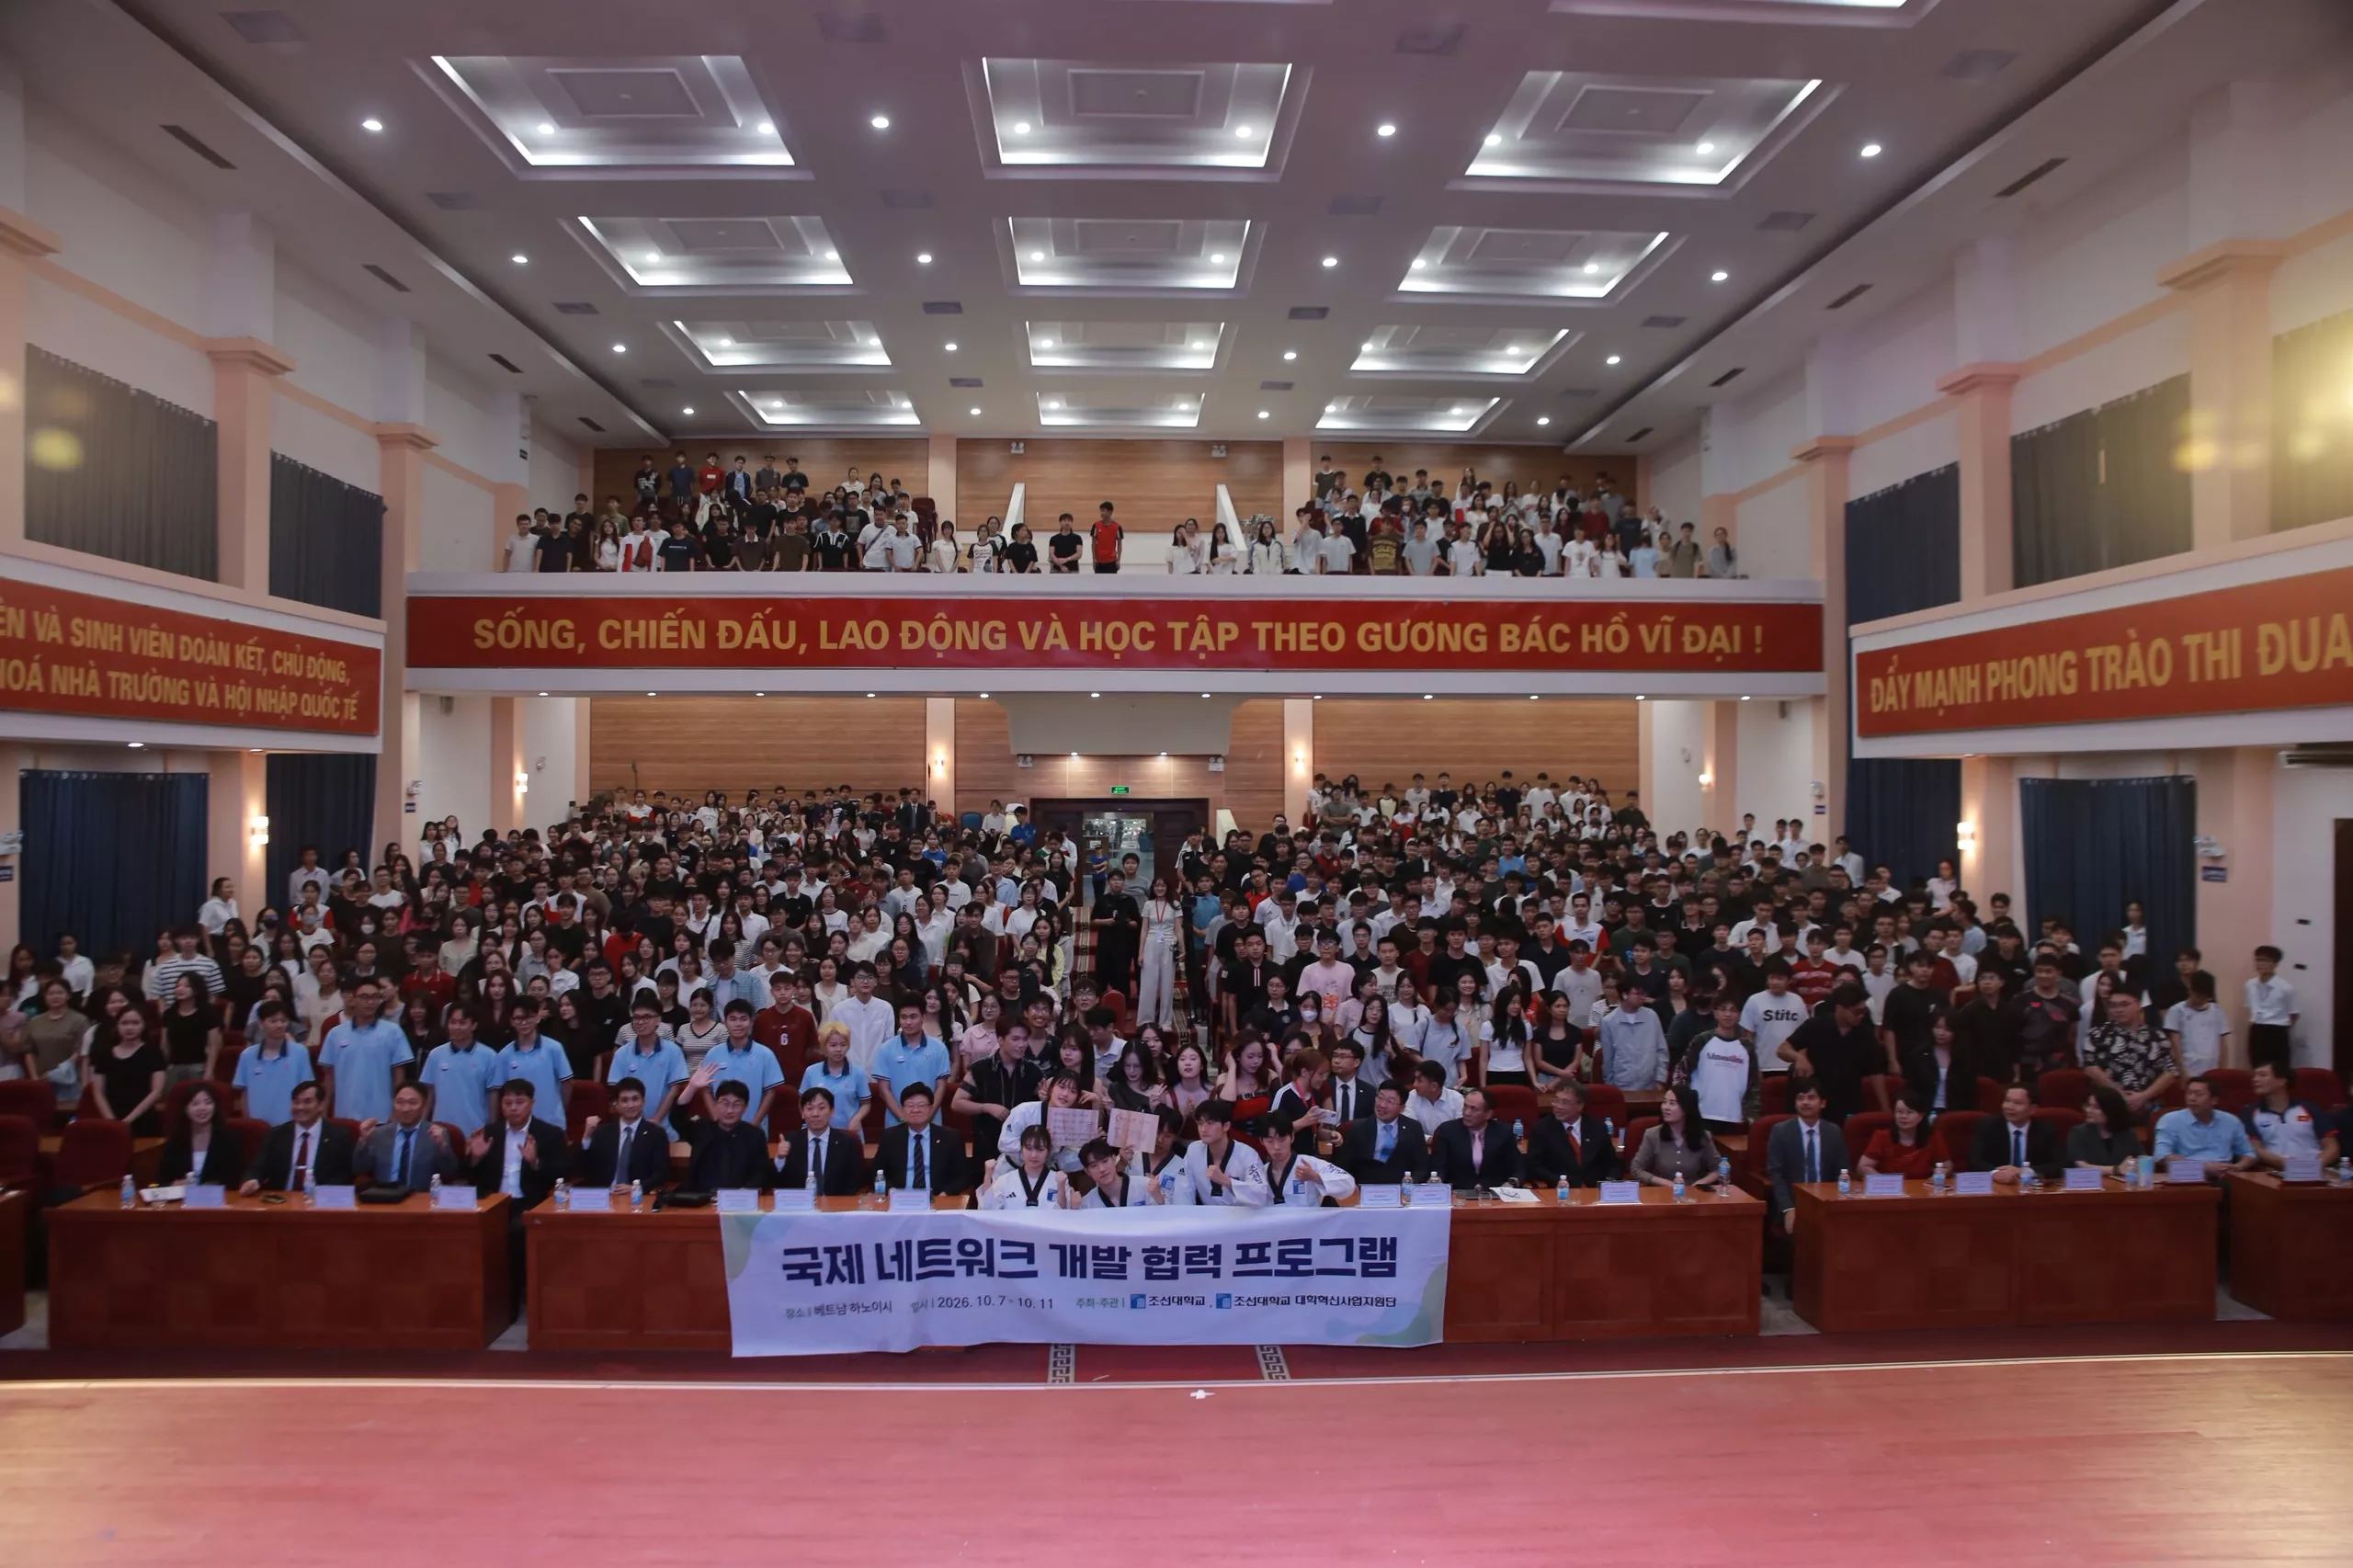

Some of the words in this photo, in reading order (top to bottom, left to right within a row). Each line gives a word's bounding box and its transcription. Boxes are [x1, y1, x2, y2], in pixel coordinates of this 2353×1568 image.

[33, 605, 63, 644] VÀ
[70, 617, 123, 652] SINH
[129, 623, 175, 660] VIÊN
[178, 631, 230, 666] ĐOÀN
[234, 636, 267, 676] KẾT,
[272, 644, 303, 677] CHỦ
[306, 652, 351, 687] ĐỘNG,
[473, 607, 585, 653] SỐNG,
[598, 608, 706, 650] CHIẾN
[717, 608, 807, 654] ĐẤU,
[819, 620, 890, 650] LAO
[899, 613, 1007, 658] ĐỘNG
[1017, 613, 1070, 651] VÀ
[1080, 620, 1155, 659] HỌC
[1167, 614, 1239, 659] TẬP
[1252, 621, 1346, 652] THEO
[1356, 619, 1487, 653] GƯƠNG
[1500, 614, 1571, 653] BÁC
[1582, 611, 1630, 653] HỒ
[1638, 615, 1675, 653] VĨ
[1681, 624, 1742, 662] ĐẠI
[1755, 625, 1764, 653] !
[1870, 653, 1912, 713] ĐẨY
[1915, 664, 1981, 717] MẠNH
[1985, 650, 2078, 702] PHONG
[2084, 628, 2173, 692] TRÀO
[2181, 628, 2242, 682] THI
[2256, 613, 2353, 676] ĐUA
[51, 660, 102, 698] NHÀ
[107, 667, 189, 706] TRƯỜNG
[194, 676, 220, 708] VÀ
[225, 679, 252, 718] HỘI
[256, 685, 298, 722] NHẬP
[301, 687, 340, 720] QUỐC
[343, 690, 360, 722] TẾ
[780, 1033, 789, 1046] 6
[782, 1243, 866, 1287] 국제
[875, 1238, 1039, 1283] 네트워크
[1049, 1243, 1132, 1280] 개발
[1142, 1243, 1222, 1280] 협력
[1233, 1236, 1398, 1278] 프로그램
[813, 1303, 847, 1316] 베트남
[849, 1301, 893, 1314] 하노이시
[938, 1296, 972, 1309] 2026.
[1040, 1298, 1053, 1310] 11
[1149, 1295, 1206, 1307] 조선대학교
[1233, 1295, 1291, 1307] 조선대학교
[1295, 1294, 1398, 1308] 대학혁신사업지원단
